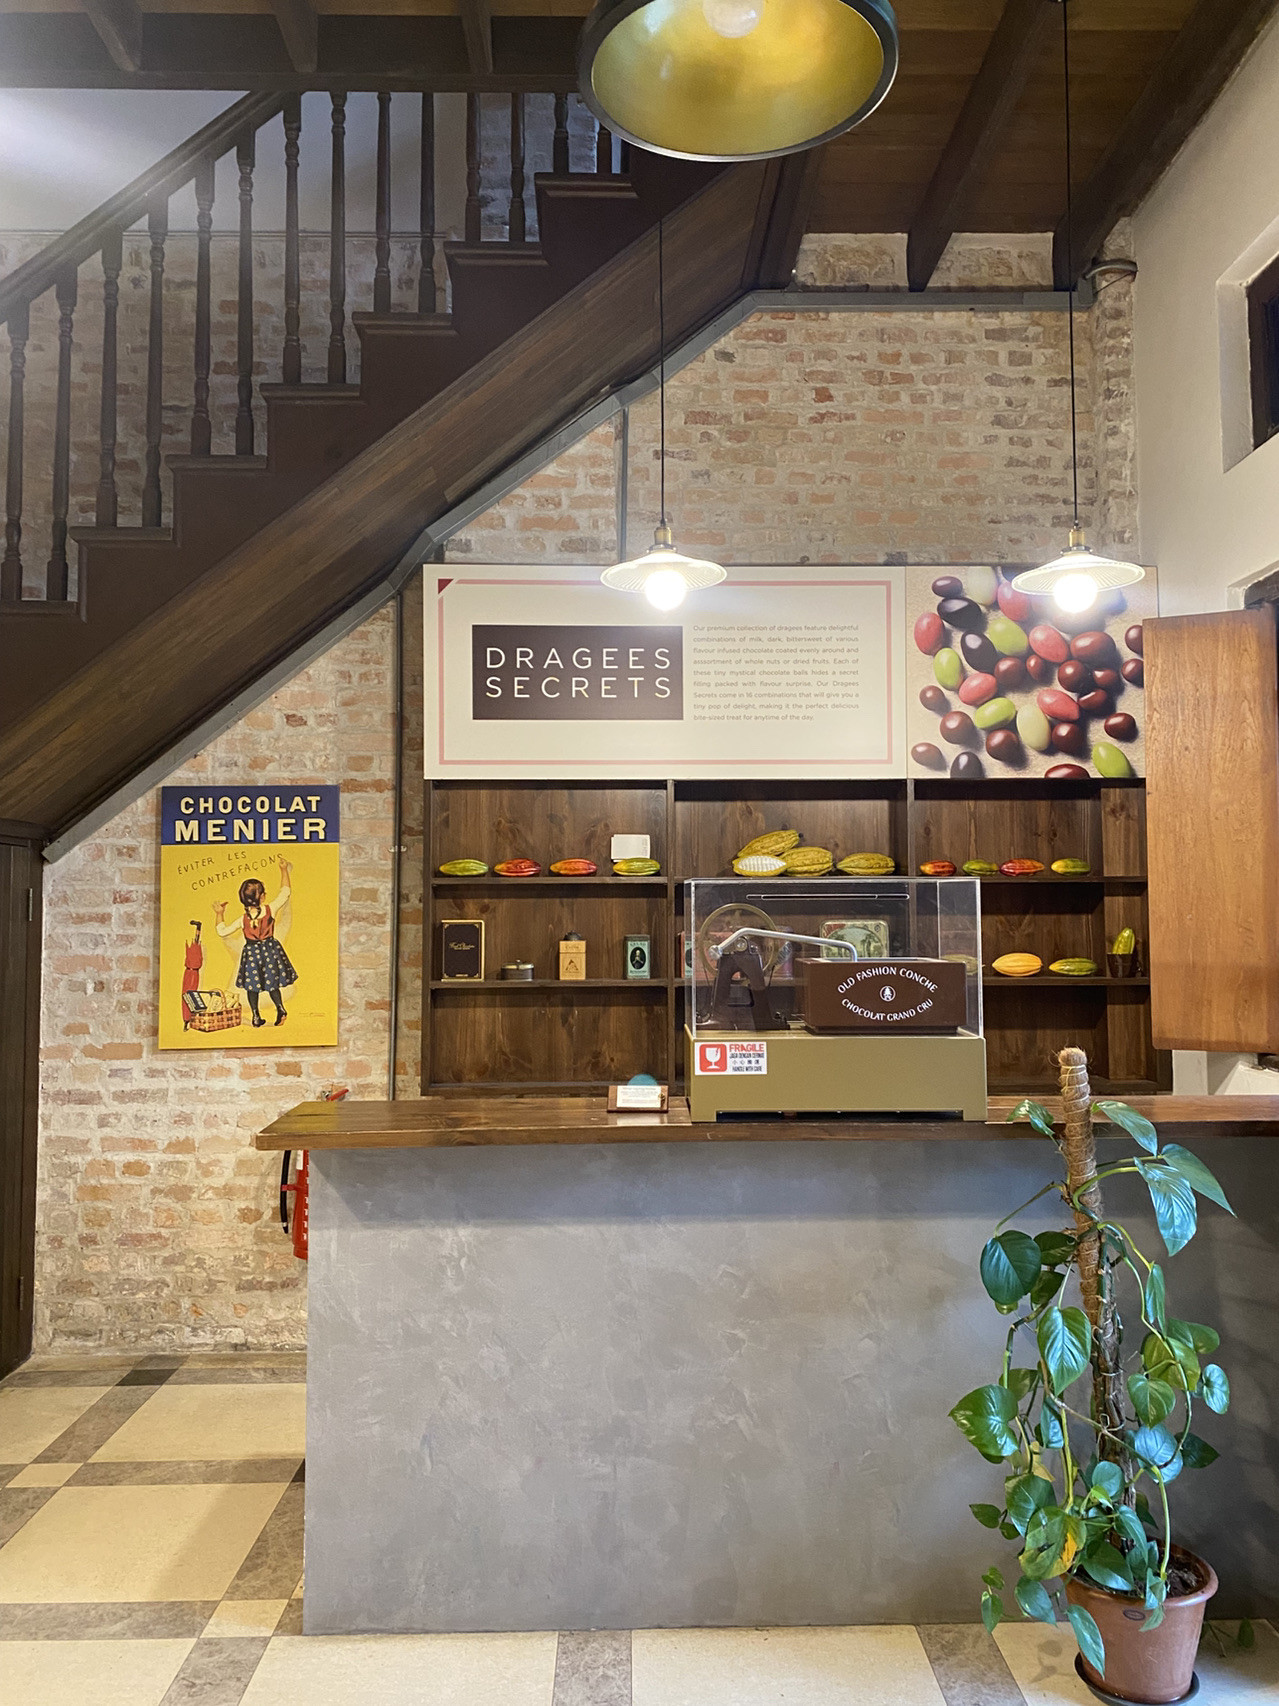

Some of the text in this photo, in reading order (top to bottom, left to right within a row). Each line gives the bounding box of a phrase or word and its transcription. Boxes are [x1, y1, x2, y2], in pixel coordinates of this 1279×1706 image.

[486, 647, 670, 669] DRAGEES
[486, 677, 671, 698] SECRETS
[180, 796, 321, 814] CHOCOLAT
[175, 818, 326, 842] MENIER
[228, 851, 247, 861] LES
[838, 966, 938, 993] OLD FASHION CONCHE
[842, 998, 933, 1021] CHOCOLAT GRAND CRU
[729, 1044, 764, 1052] FRAGILE
